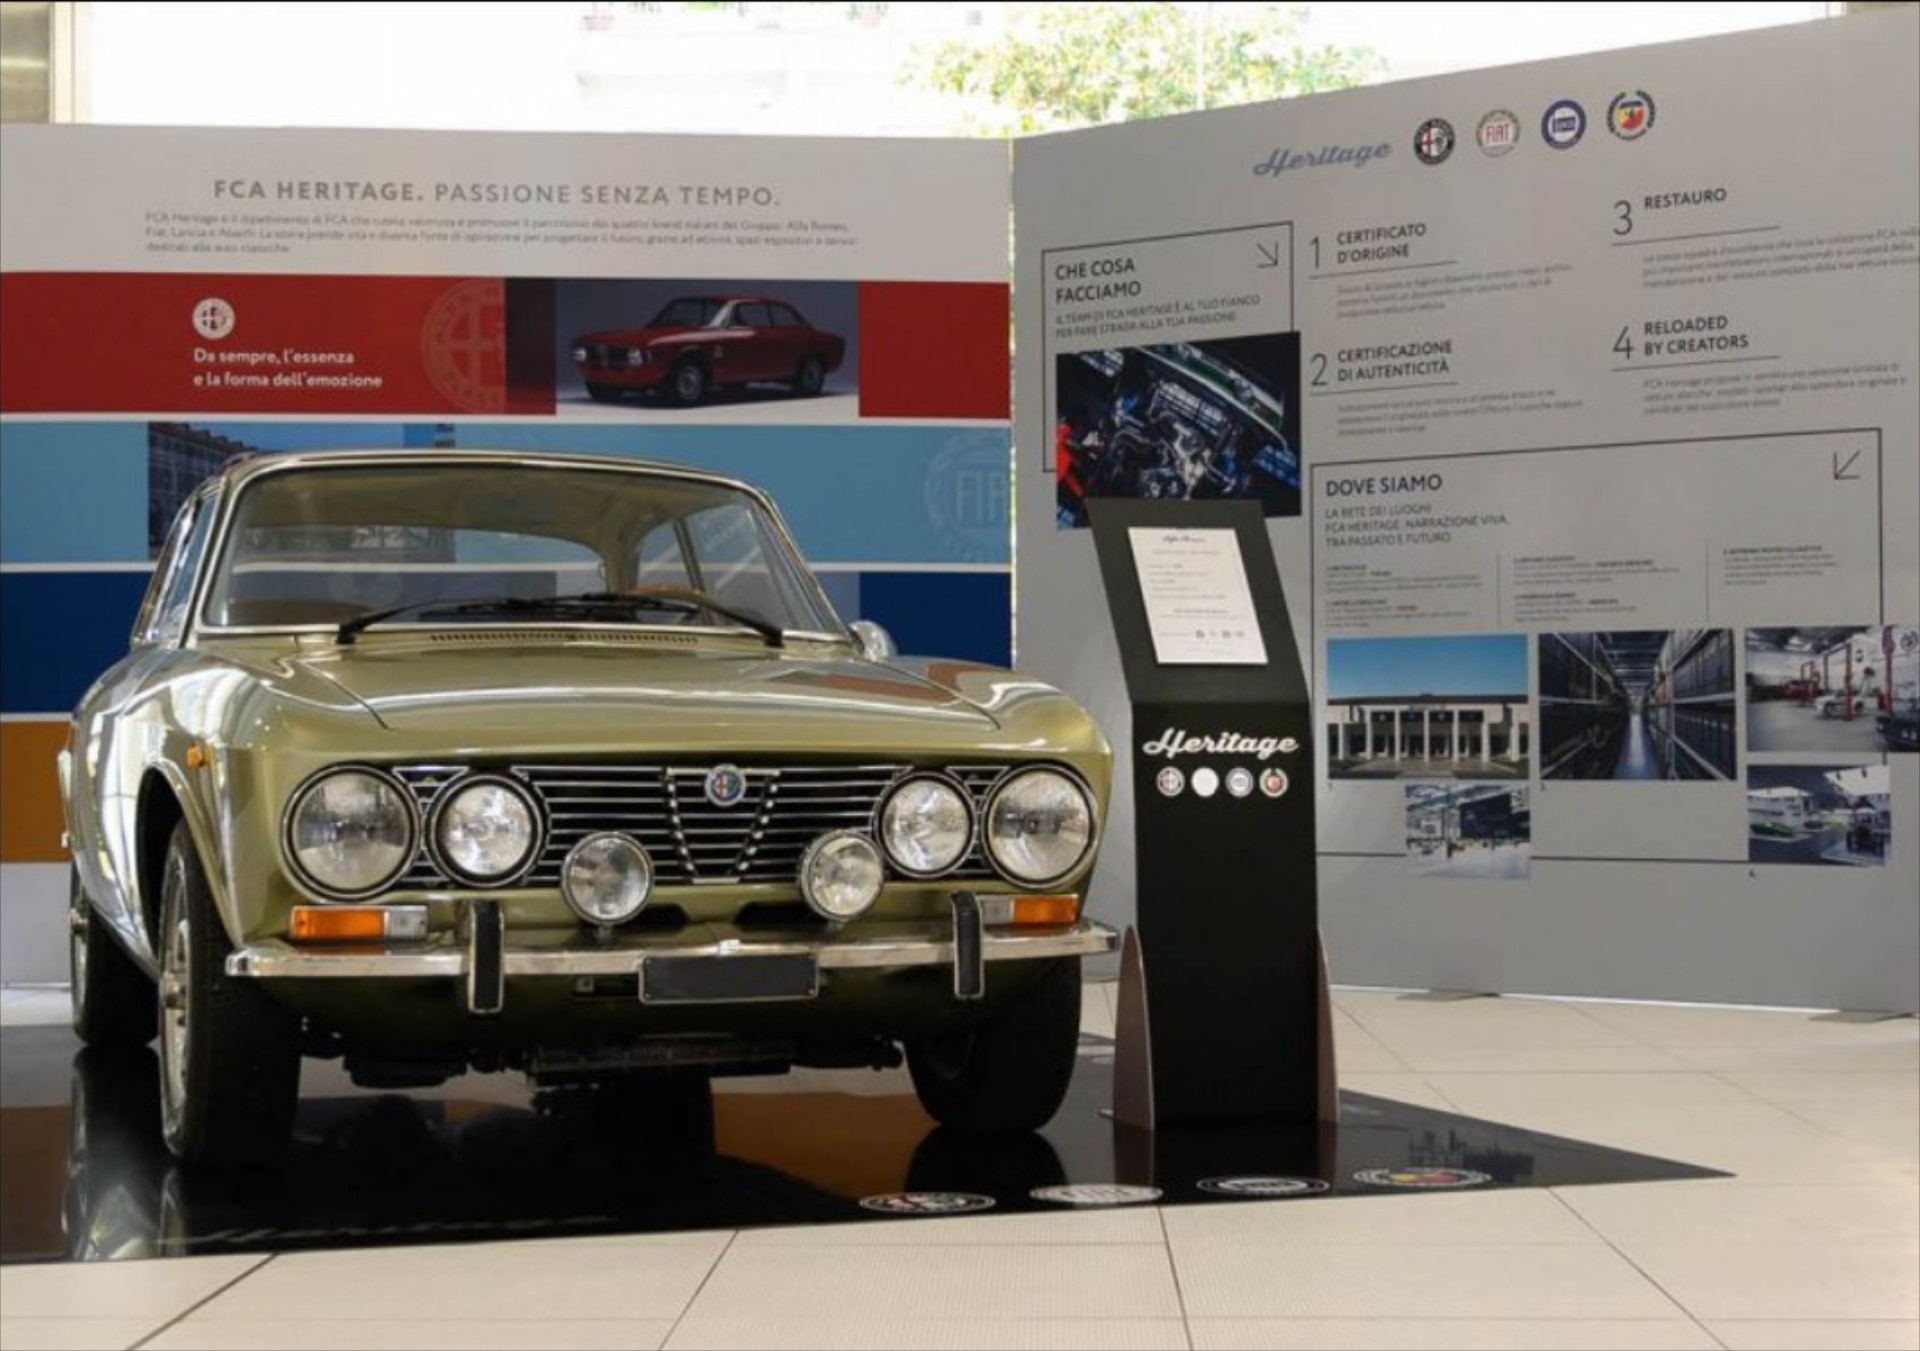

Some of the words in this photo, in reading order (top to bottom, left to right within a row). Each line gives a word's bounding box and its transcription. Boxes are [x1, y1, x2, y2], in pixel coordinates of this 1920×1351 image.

[1486, 122, 1511, 144] FIAT
[1253, 142, 1393, 177] Heritage
[214, 179, 266, 199] FCA
[278, 180, 424, 201] HERITAGE.
[435, 183, 570, 203] PASSIONE
[581, 185, 669, 205] SENZA
[679, 186, 780, 207] TEMPO.
[1643, 188, 1728, 210] RESTAURO
[1612, 200, 1633, 236] 3
[1336, 223, 1428, 246] CERTIFICATO
[1309, 236, 1321, 269] 1
[1336, 244, 1410, 264] D'ORIGINE
[1055, 263, 1087, 281] CHE
[1090, 257, 1136, 277] COSA
[1055, 281, 1142, 305] FACCIAMO
[1643, 315, 1729, 335] RELOADED
[1337, 339, 1454, 364] CERTIFICAZIONE
[1611, 326, 1634, 360] 4
[1643, 343, 1662, 356] BY
[1666, 334, 1750, 354] CREATORS
[194, 349, 214, 364] Da
[219, 351, 281, 366] sempre,
[284, 349, 355, 365] l'essenza
[1337, 368, 1352, 382] DI
[1355, 357, 1450, 380] AUTENTICITÀ
[194, 375, 204, 387] e
[207, 372, 222, 387] la
[225, 372, 270, 388] forma
[273, 372, 384, 388] dell'emozione
[1310, 353, 1329, 387] 2
[955, 469, 1007, 523] FIA
[1325, 477, 1375, 497] DOVE
[1380, 473, 1443, 494] SIAMO
[1141, 726, 1300, 761] Heritage
